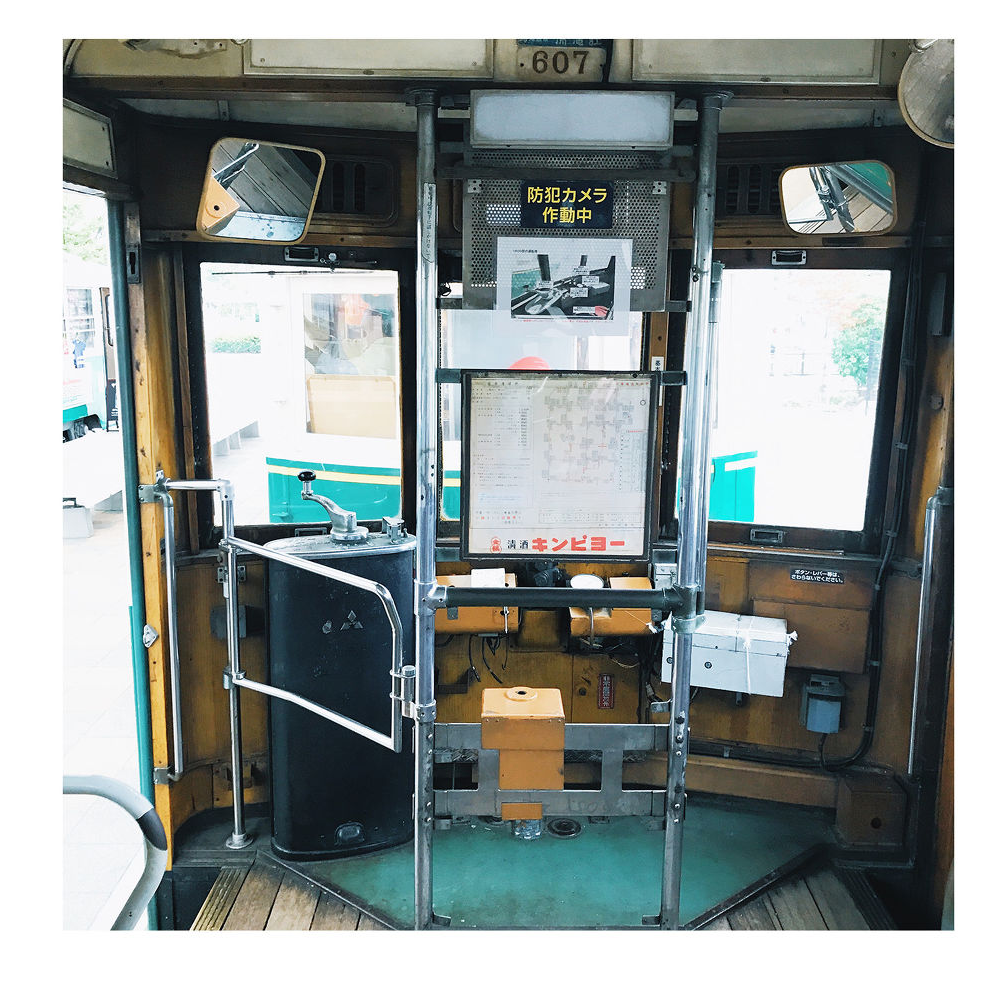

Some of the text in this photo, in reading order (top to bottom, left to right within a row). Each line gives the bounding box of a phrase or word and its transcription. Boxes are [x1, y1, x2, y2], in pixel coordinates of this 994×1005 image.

[532, 50, 589, 74] 607
[527, 187, 608, 204] 防犯カメラ
[542, 207, 592, 224] 作動中
[507, 539, 529, 550] 清酒
